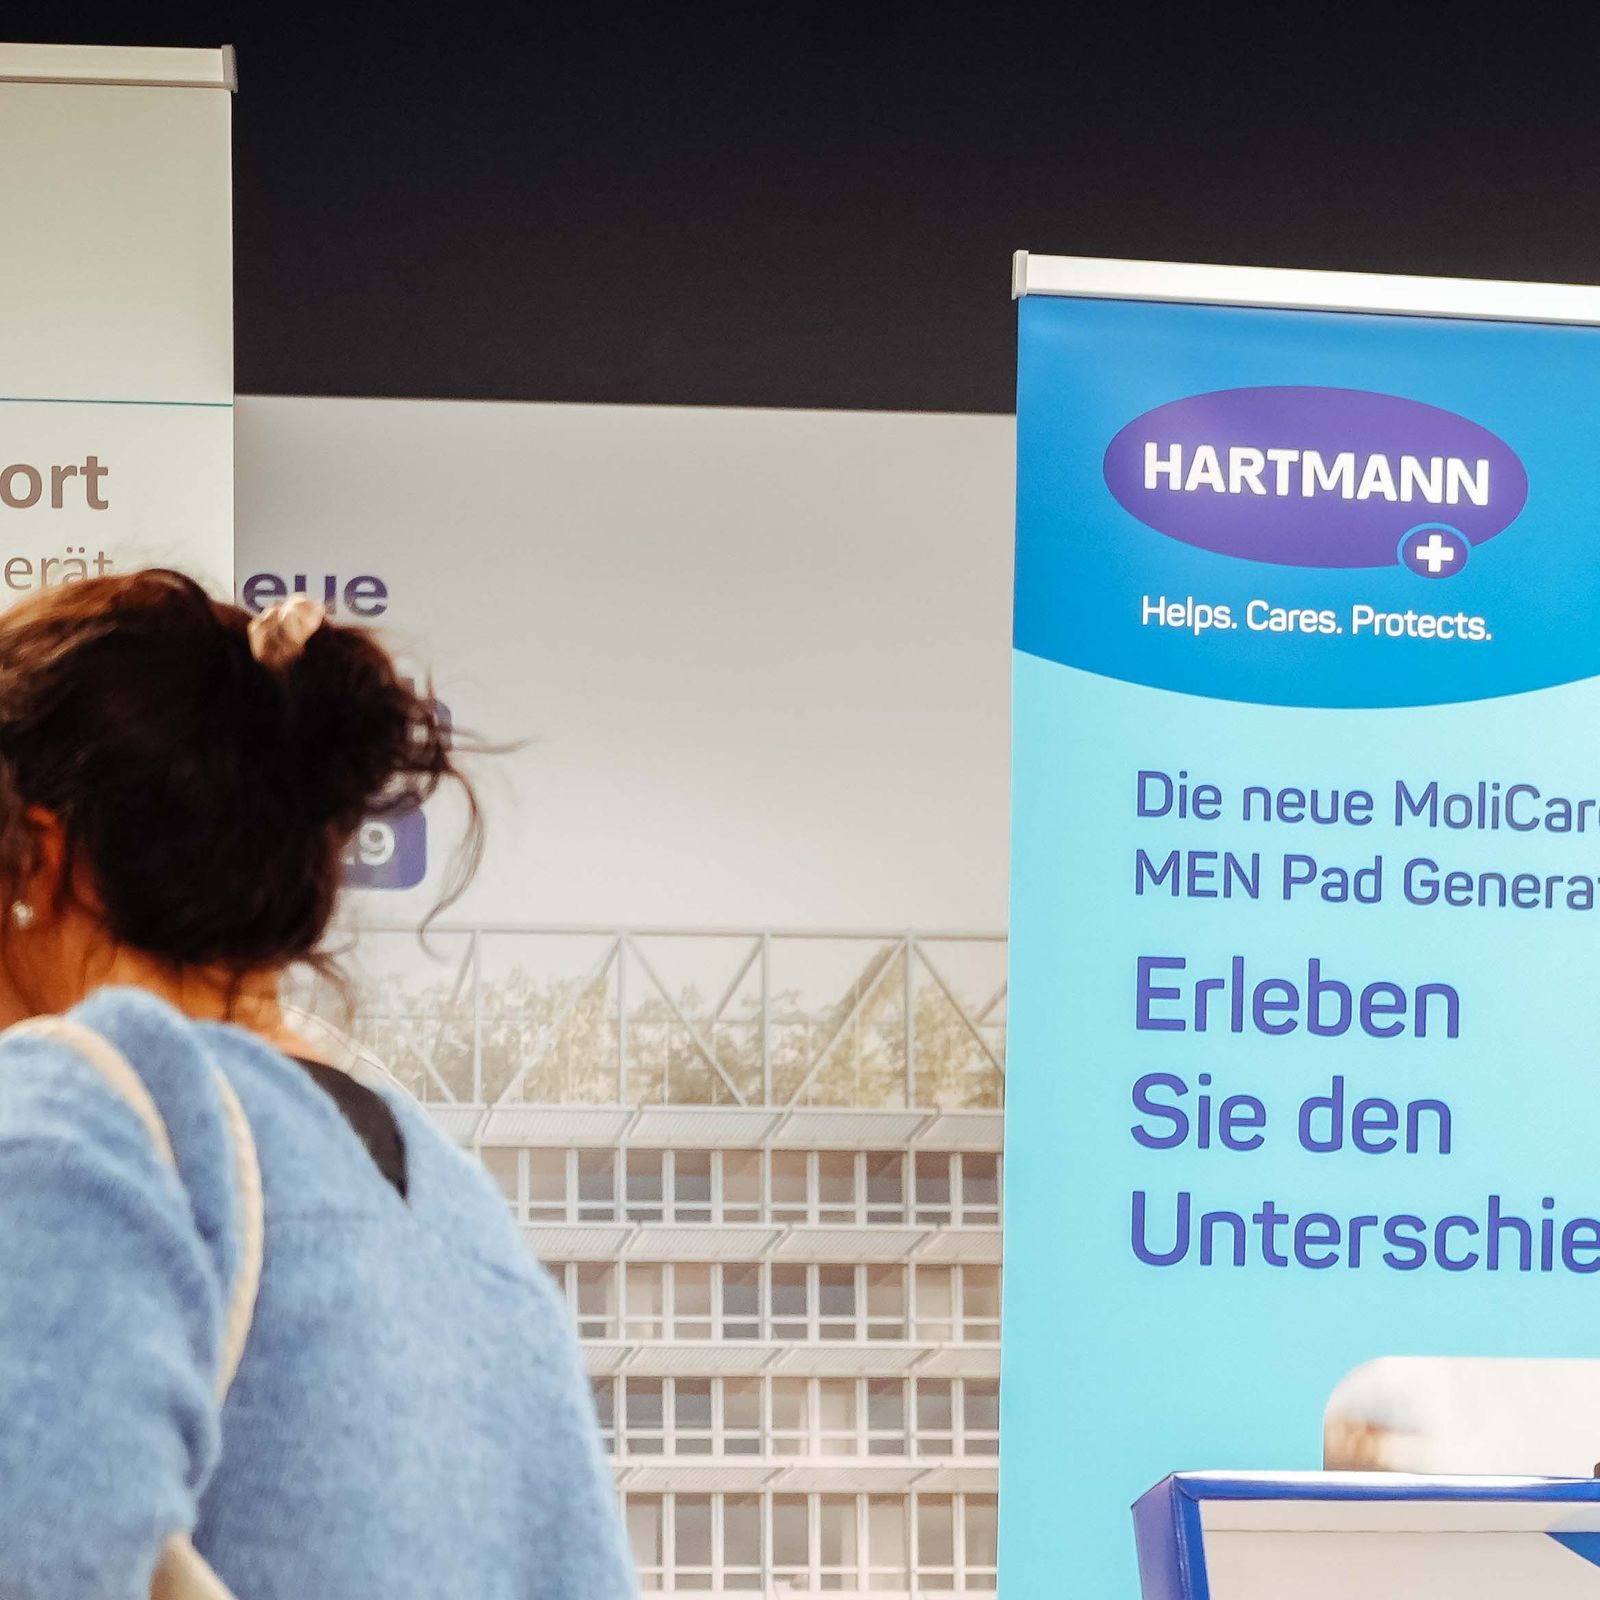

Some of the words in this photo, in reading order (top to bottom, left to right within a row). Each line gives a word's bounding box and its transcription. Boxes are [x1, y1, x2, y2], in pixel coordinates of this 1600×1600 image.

[1143, 441, 1489, 506] HARTMANN
[1142, 596, 1239, 636] Helps.
[1246, 600, 1344, 635] Cares.
[1352, 604, 1493, 642] Protects.
[1135, 770, 1222, 821] Die
[1242, 783, 1374, 826] neue
[1134, 849, 1260, 900] MEN
[1282, 853, 1382, 904] Pad
[1135, 955, 1461, 1039] Erleben
[1130, 1071, 1267, 1150] Sie
[1298, 1075, 1452, 1156] den
